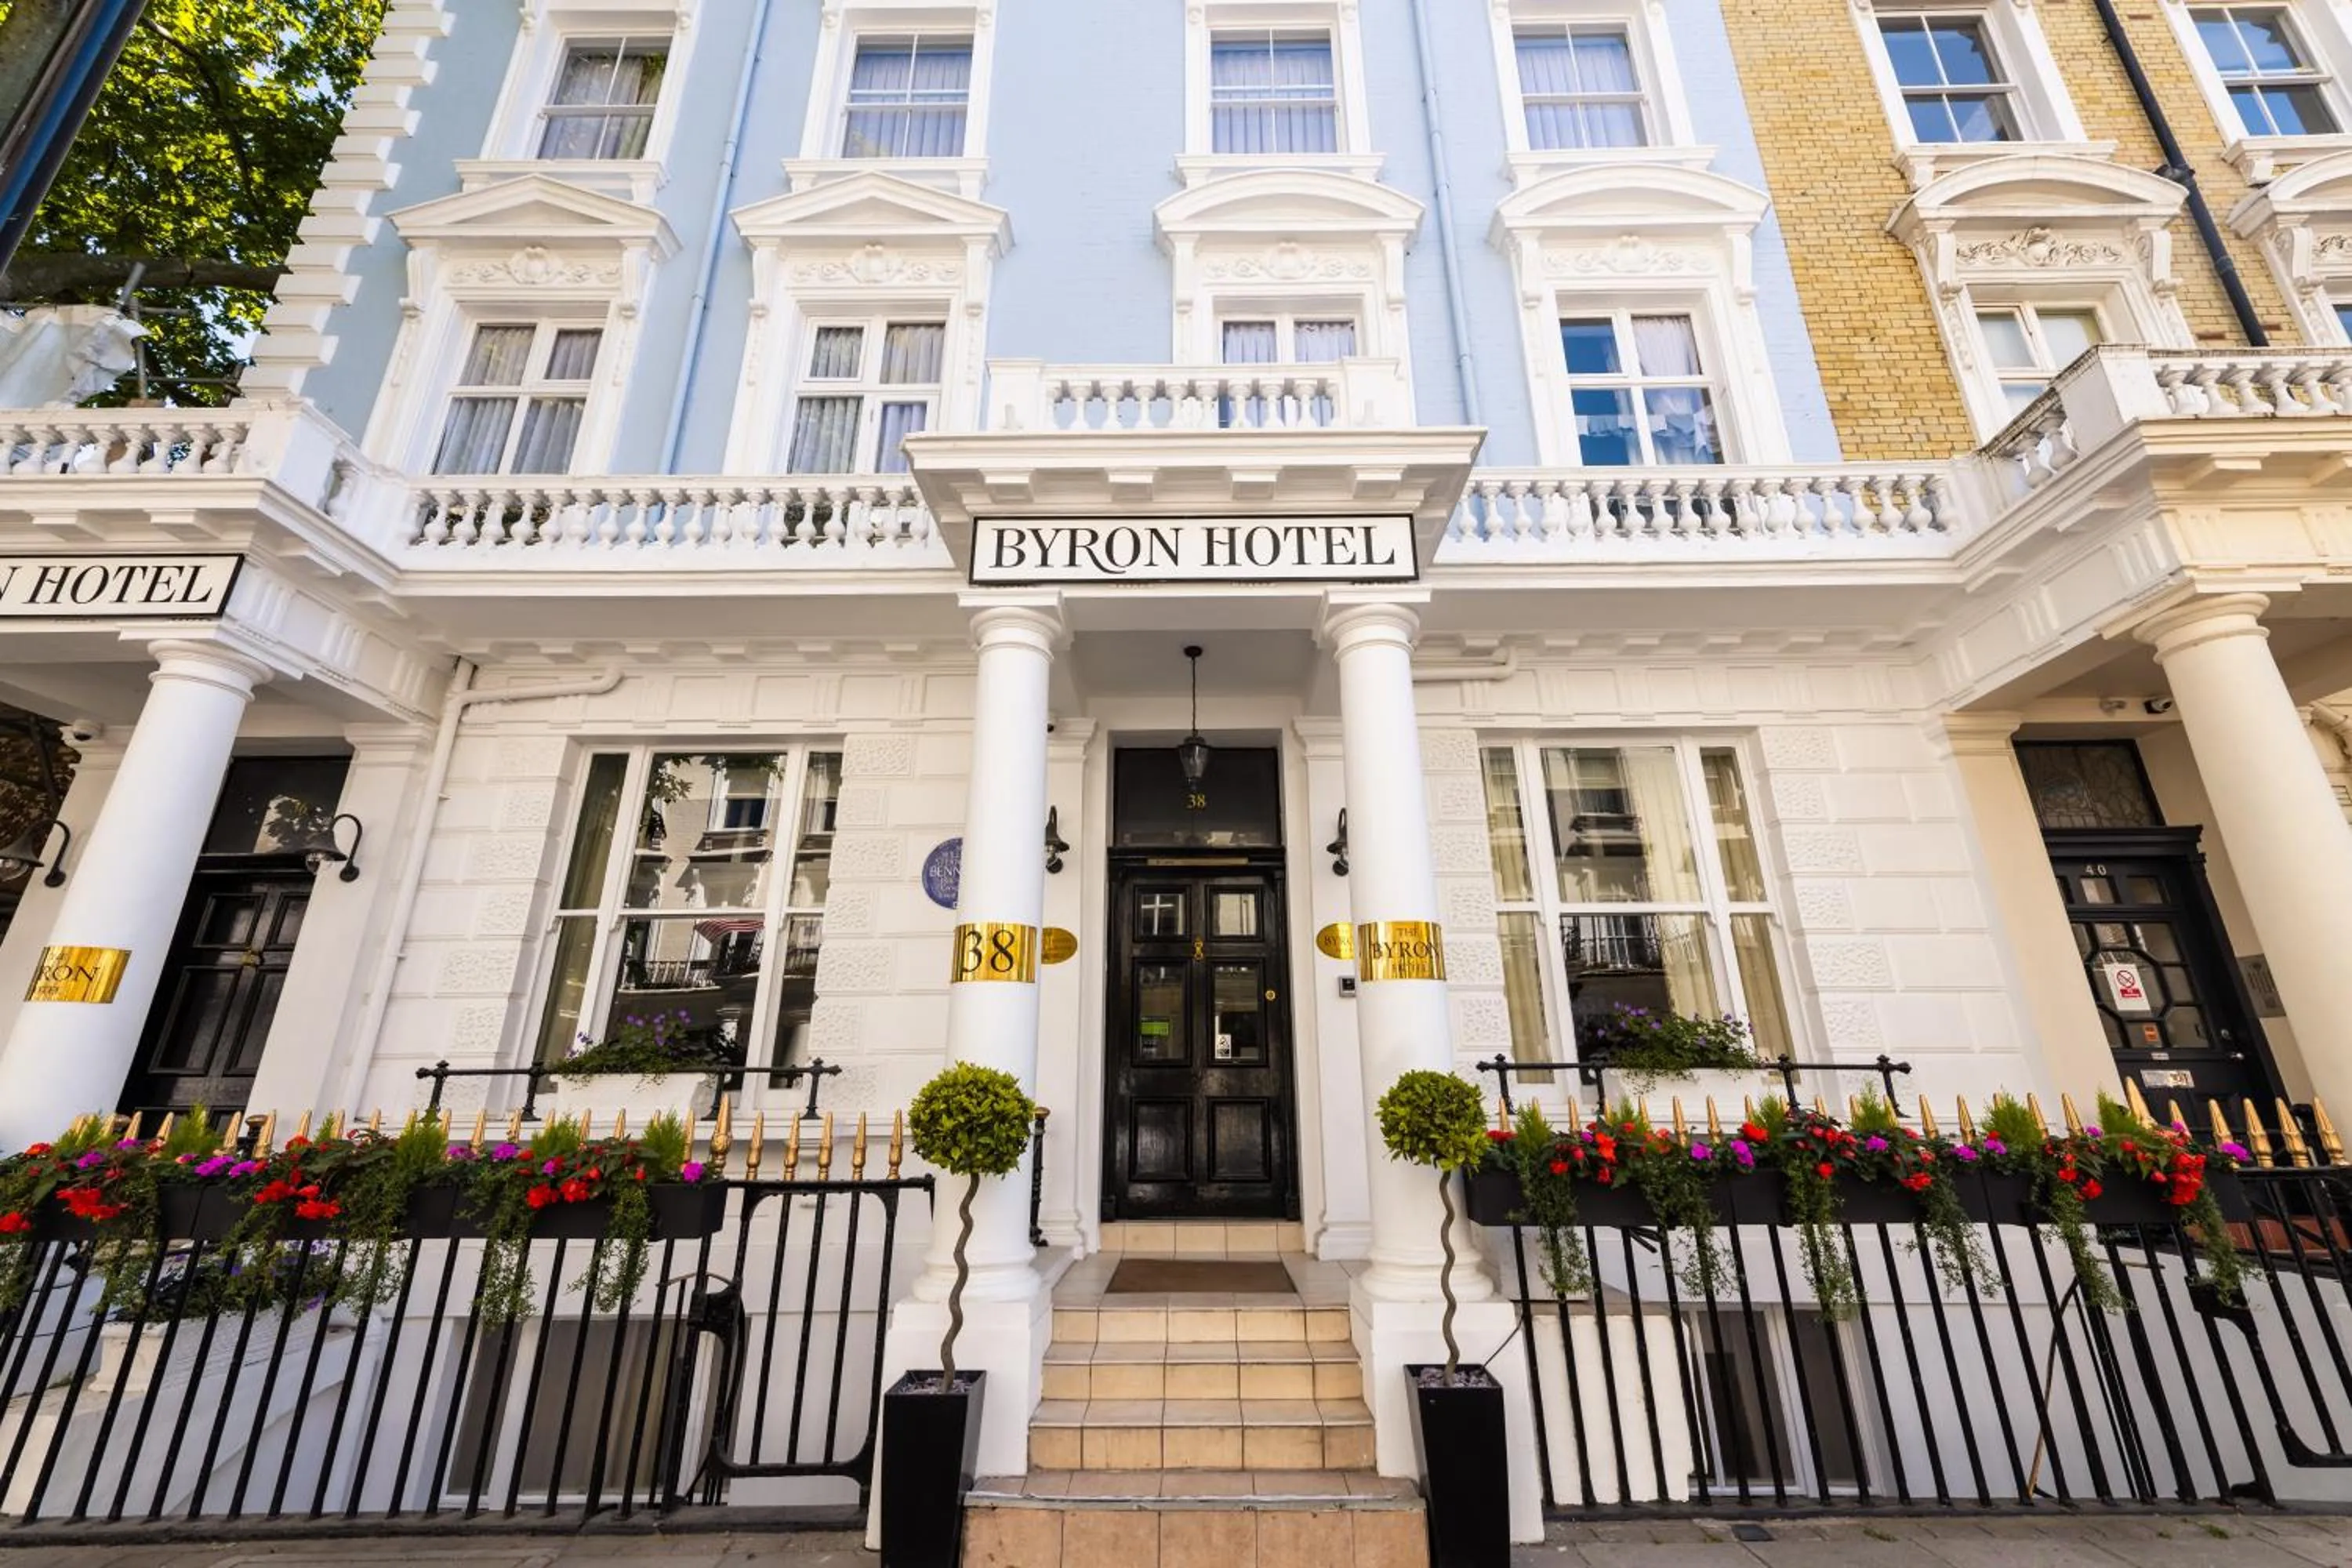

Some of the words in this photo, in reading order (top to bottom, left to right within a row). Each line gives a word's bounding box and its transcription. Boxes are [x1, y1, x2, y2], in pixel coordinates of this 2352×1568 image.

[988, 525, 1183, 574] BYRON
[1200, 525, 1396, 568] HOTEL
[22, 564, 212, 604] HOTEL
[1187, 793, 1206, 809] 38
[2085, 864, 2107, 876] 40
[962, 929, 1015, 973] 38
[1371, 940, 1439, 960] BYRON
